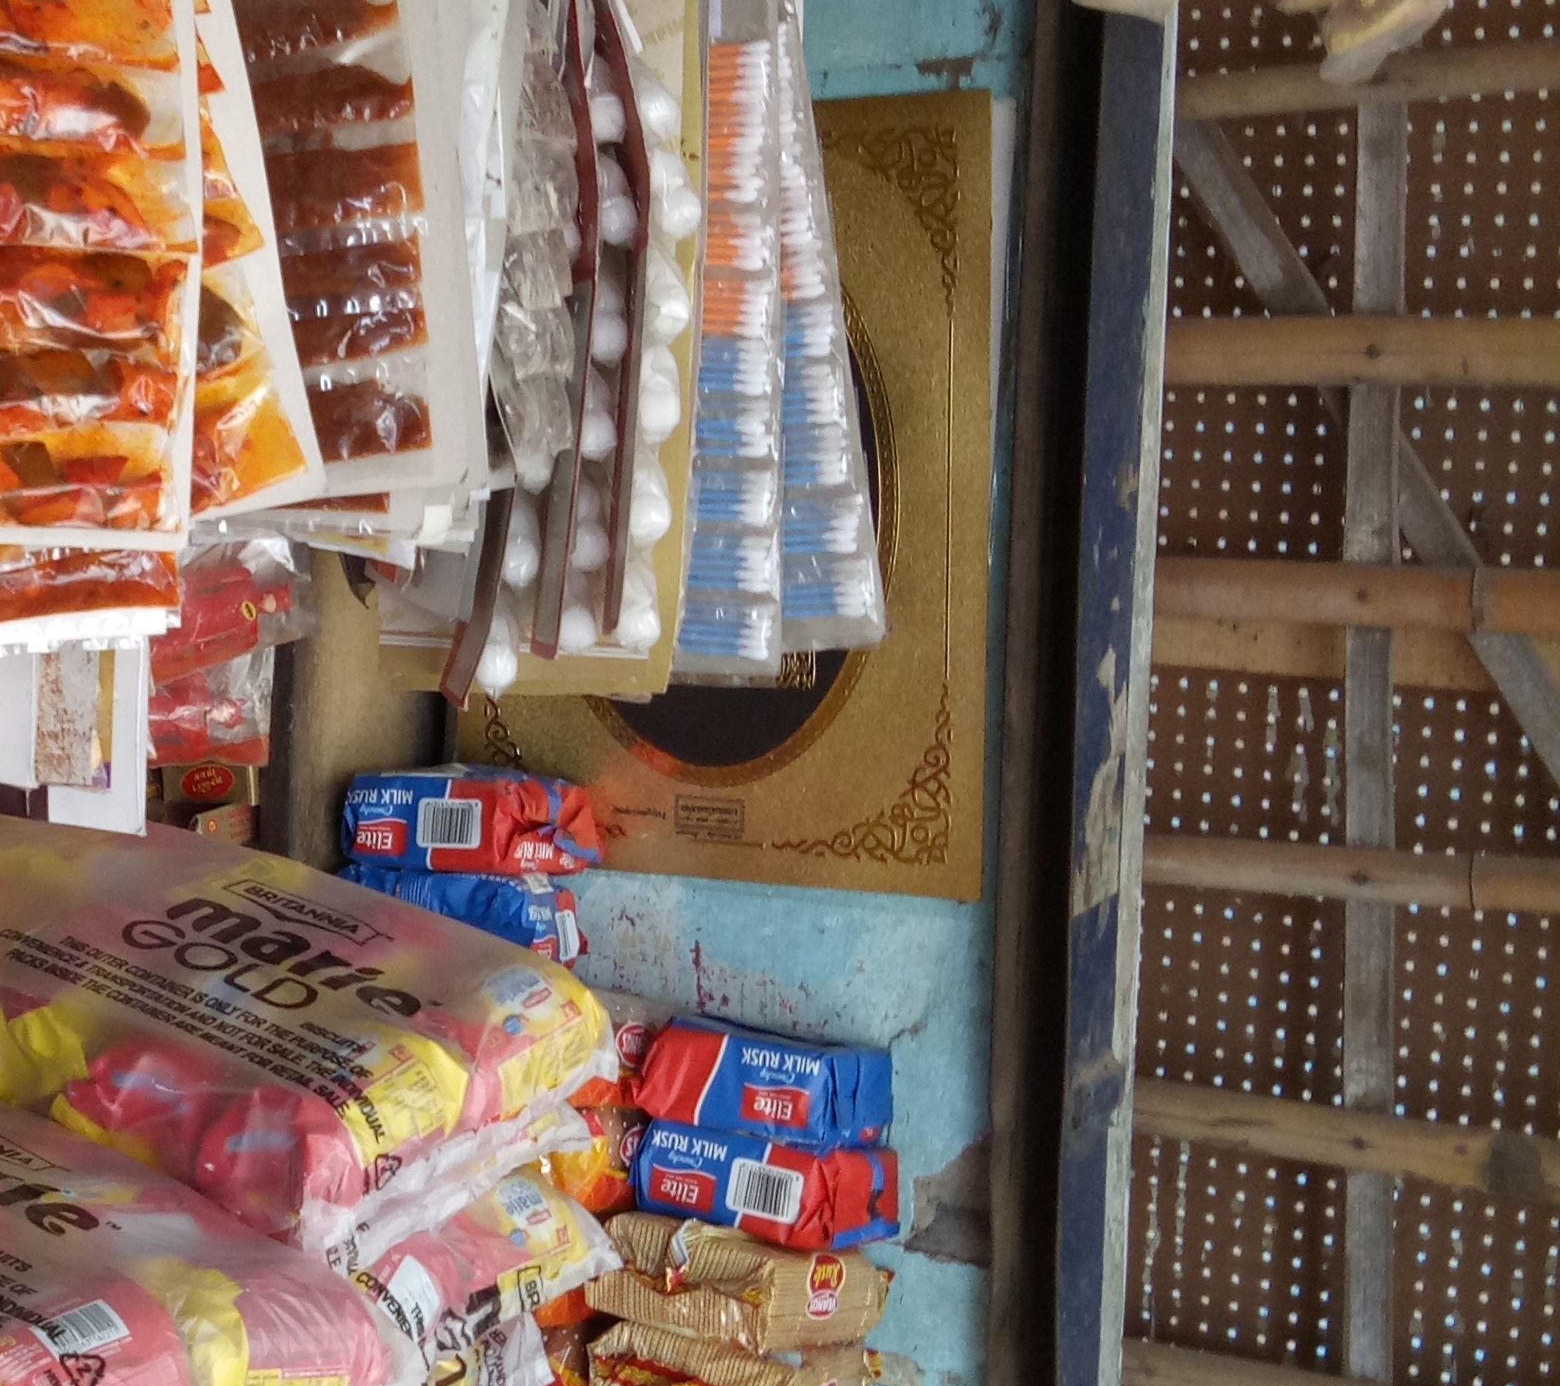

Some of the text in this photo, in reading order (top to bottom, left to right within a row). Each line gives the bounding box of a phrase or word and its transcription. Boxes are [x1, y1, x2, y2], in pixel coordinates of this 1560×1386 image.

[381, 789, 414, 806] MILK
[357, 830, 394, 851] Elite
[242, 883, 362, 935] BRITANNIA
[122, 920, 318, 1010] GOLD
[166, 897, 422, 1017] marie
[82, 979, 110, 996] THE
[240, 1050, 273, 1069] FOR
[87, 946, 129, 969] OUTER
[125, 963, 195, 1000] CONTAINER
[190, 989, 208, 1004] IS
[205, 996, 241, 1016] ONLY
[239, 1010, 268, 1028] FOR
[263, 1021, 293, 1043] THE
[289, 1033, 356, 1069] PURPOSE
[350, 1063, 374, 1080] OF
[186, 1008, 216, 1027] AND
[214, 1020, 243, 1038] NOT
[241, 1031, 274, 1052] FOR
[304, 1060, 336, 1080] THE
[741, 1047, 821, 1076] MILK RUSK
[753, 1095, 794, 1121] Elite
[651, 1129, 729, 1162] MILK RUSK
[660, 1177, 700, 1205] Elite
[812, 1259, 841, 1289] Rusk
[7, 1282, 38, 1298] OF
